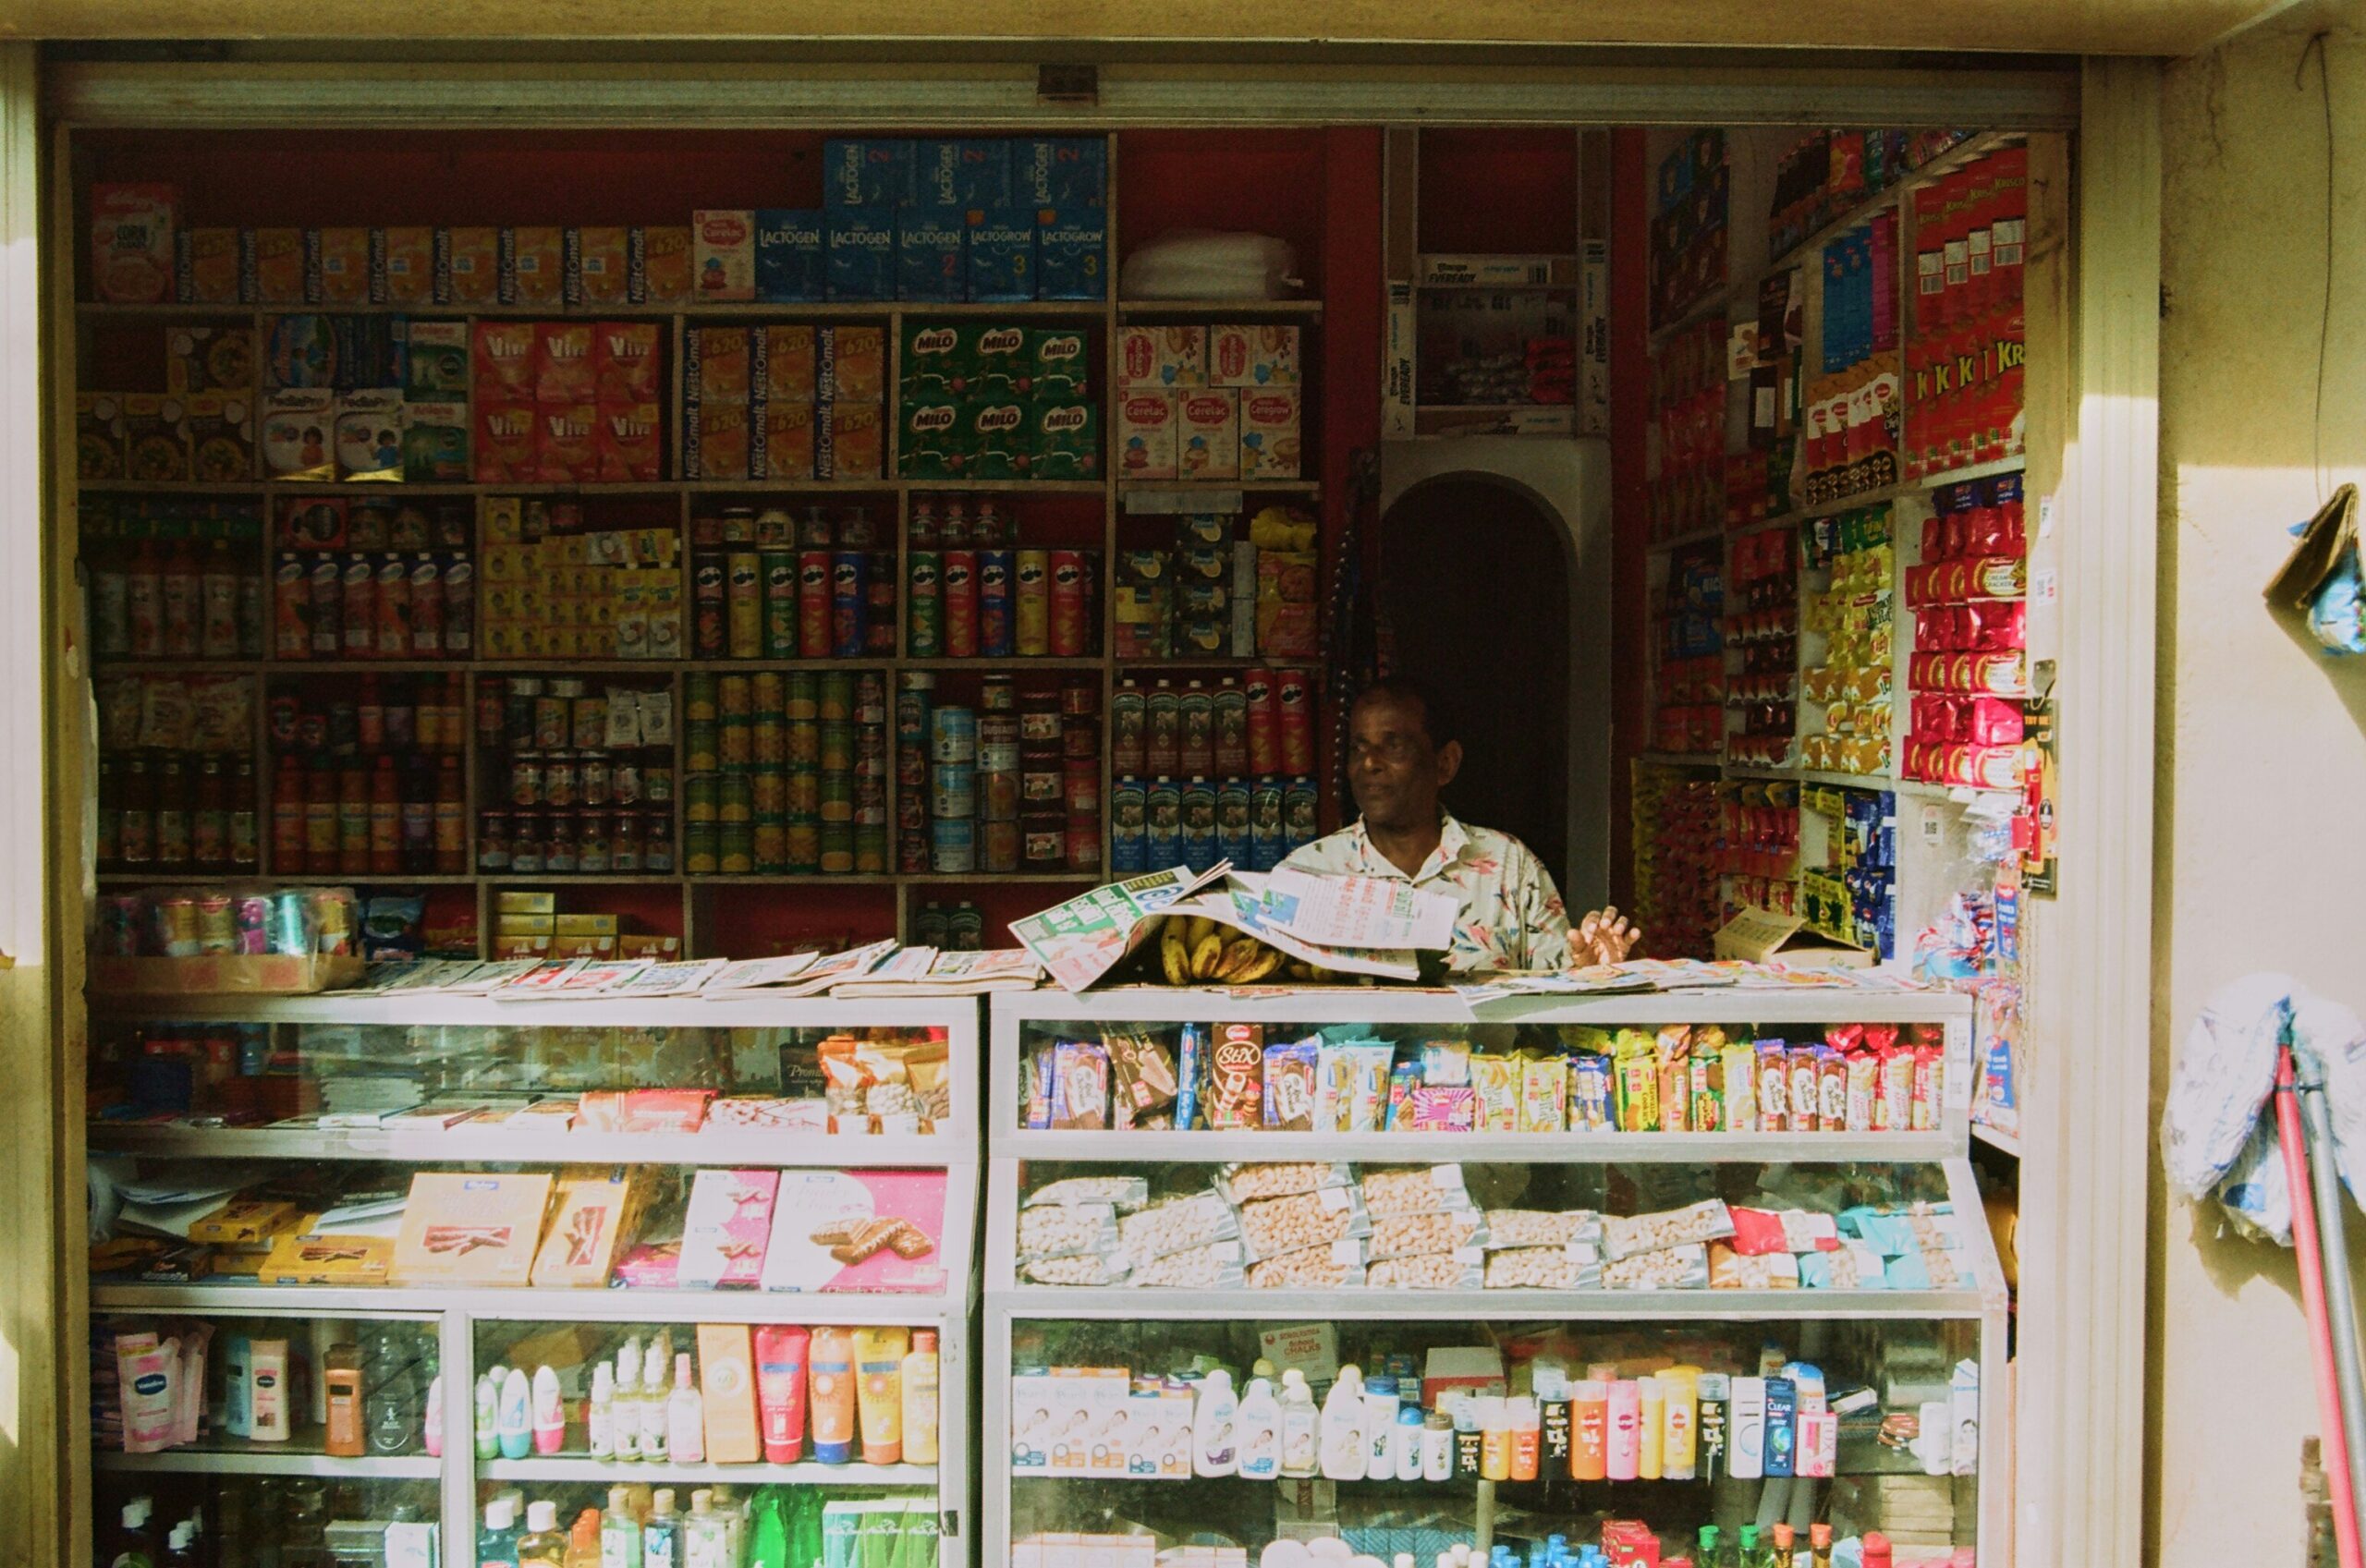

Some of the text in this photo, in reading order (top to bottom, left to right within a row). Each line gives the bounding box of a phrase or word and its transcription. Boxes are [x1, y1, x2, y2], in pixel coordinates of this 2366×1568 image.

[843, 143, 862, 205] LACTOGEN
[938, 143, 957, 205] LACTOGEN
[1033, 142, 1052, 204] LACTOGEN
[760, 229, 820, 248] LACTOGEN
[831, 229, 891, 248] LACTOGEN
[901, 229, 961, 248] LACTOGEN
[971, 229, 1031, 245] LACTOGROW
[1043, 229, 1103, 246] LACTOGROW
[942, 252, 957, 275] 2
[1013, 254, 1027, 275] 3
[1084, 254, 1098, 275] 3
[1428, 273, 1476, 283] EVEREADY
[918, 335, 953, 350] MILO
[982, 335, 1018, 350] MILO
[1595, 316, 1606, 363] EVEREADY
[1044, 344, 1077, 357] MILO
[1996, 340, 2025, 373] KR
[1400, 358, 1410, 405] EVEREADY
[916, 412, 951, 427] MILO
[981, 412, 1017, 427] MILO
[1047, 413, 1083, 427] MILO
[1767, 1401, 1792, 1413] CLEAR
